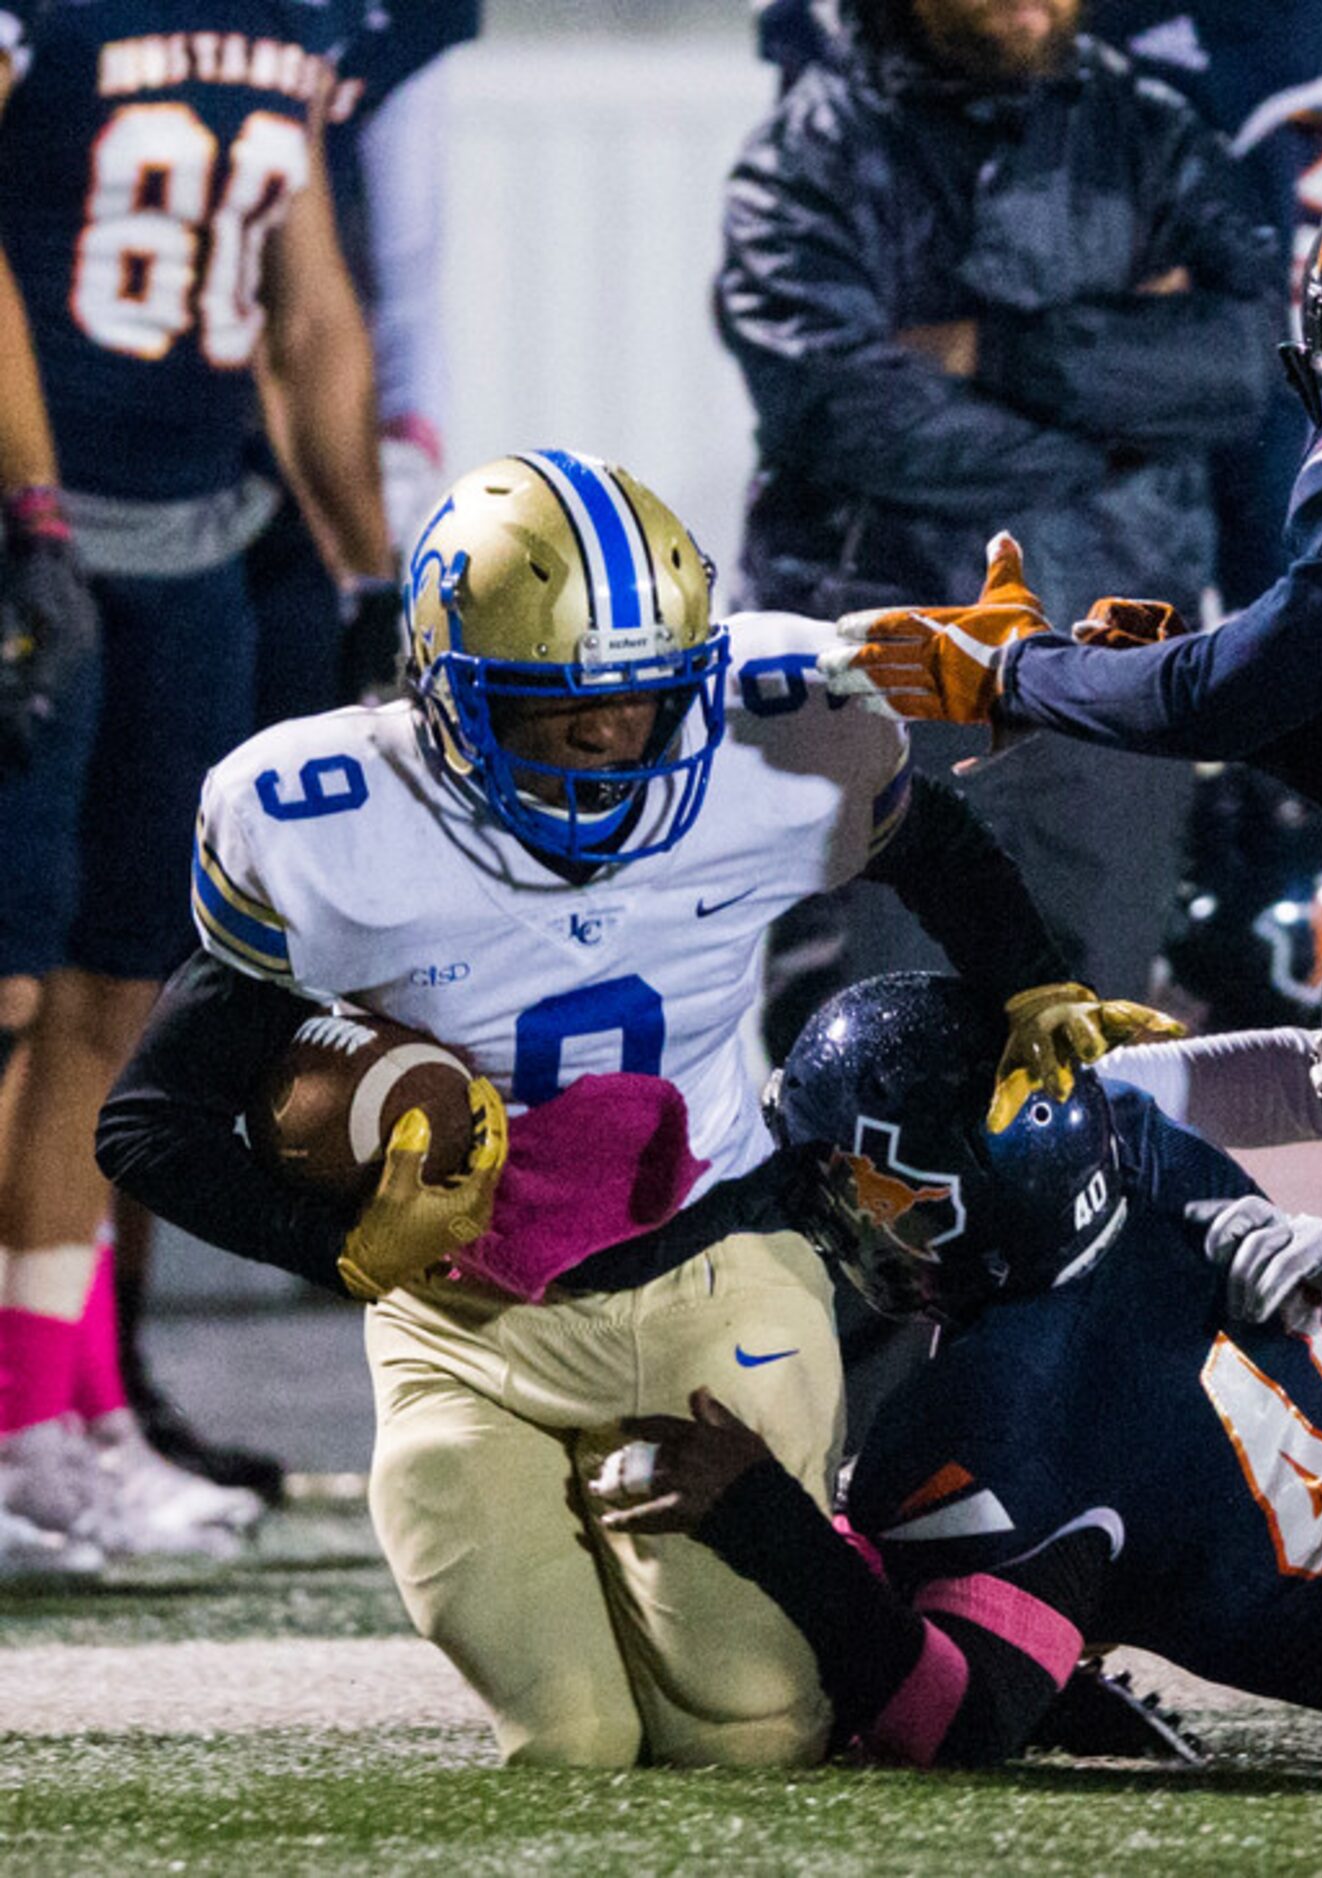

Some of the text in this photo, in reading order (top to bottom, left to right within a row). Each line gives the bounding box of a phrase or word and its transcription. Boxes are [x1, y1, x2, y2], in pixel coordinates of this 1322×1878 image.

[71, 102, 307, 368] 80
[255, 754, 369, 821] 9
[1074, 1170, 1108, 1232] 40
